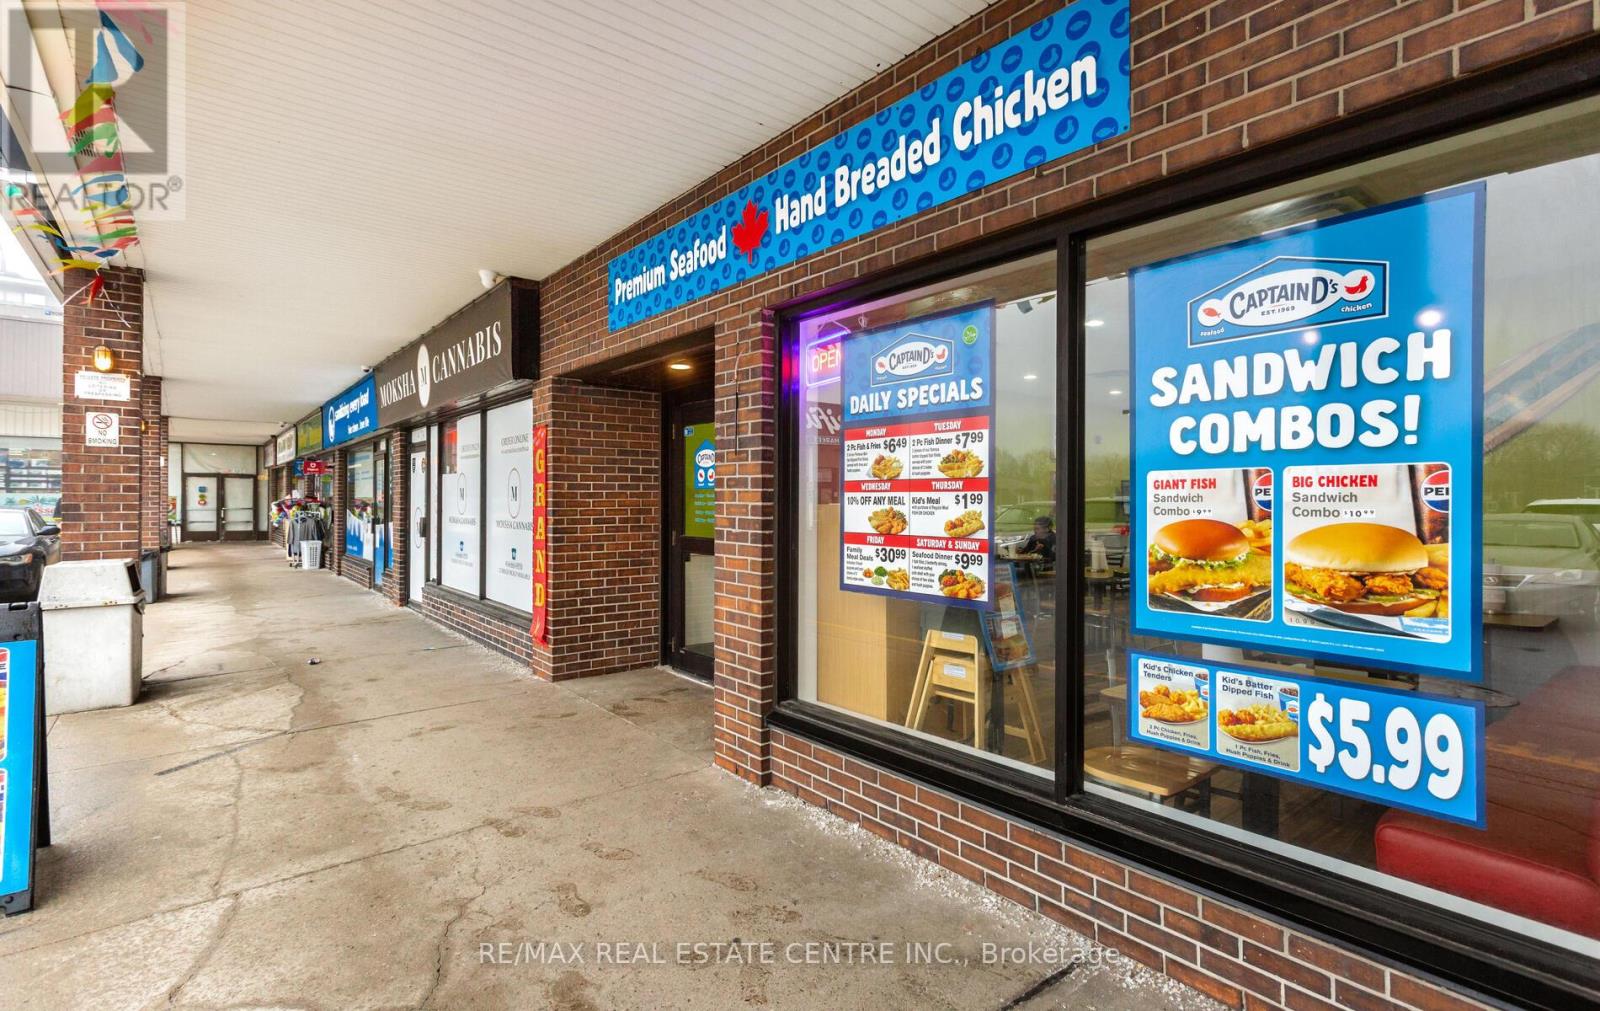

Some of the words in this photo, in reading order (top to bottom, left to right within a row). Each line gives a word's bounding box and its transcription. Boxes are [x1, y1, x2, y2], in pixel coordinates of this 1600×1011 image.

[775, 176, 826, 235] Hand
[834, 117, 941, 208] Breaded
[953, 55, 1097, 151] Chicken
[615, 263, 666, 305] Premium
[670, 225, 726, 281] Seafood
[1340, 302, 1372, 312] chicken
[1200, 327, 1224, 336] seafood
[380, 369, 416, 409] MOKSHA
[432, 320, 502, 384] CANNABIS
[1149, 328, 1451, 408] SANDWICH
[850, 390, 892, 415] DAILY
[896, 376, 983, 409] SPECIALS
[934, 421, 962, 431] TUESDAY
[1168, 394, 1422, 456] COMBOS!
[866, 428, 886, 437] MONDAY
[935, 436, 953, 445] Dinner
[861, 482, 891, 491] WEDNESDAY
[932, 481, 963, 490] THURSDAY
[1154, 479, 1187, 490] GIANT
[1191, 478, 1216, 489] FISH
[1292, 476, 1313, 488] BIG
[1318, 475, 1378, 487] CHICKEN
[511, 486, 517, 502] M
[1154, 493, 1203, 503] Sandwich
[1292, 492, 1358, 503] Sandwich
[847, 497, 859, 505] 10%
[860, 496, 872, 505] OFF
[873, 496, 886, 505] ANY
[887, 496, 906, 505] MEAL
[912, 496, 925, 505] Kid's
[926, 496, 940, 505] Meal
[1154, 506, 1190, 516] Combo
[1292, 506, 1340, 518] Combo
[535, 449, 545, 607] GRAND
[866, 536, 884, 544] FRIDAY
[916, 539, 946, 548] SATURDAY
[955, 542, 980, 550] SUNDAY
[1144, 663, 1162, 672] Kid's
[1163, 666, 1193, 677] Chicken
[1144, 671, 1172, 682] Tenders
[1222, 676, 1242, 686] Kid's
[1246, 680, 1273, 691] Batter
[1222, 685, 1252, 697] Dipped
[1255, 690, 1274, 700] Fish
[1160, 732, 1180, 742] Puppies
[1308, 692, 1464, 800] $5.99
[1226, 748, 1240, 756] Hush
[1242, 751, 1266, 763] Puppies
[1273, 758, 1290, 768] Drink
